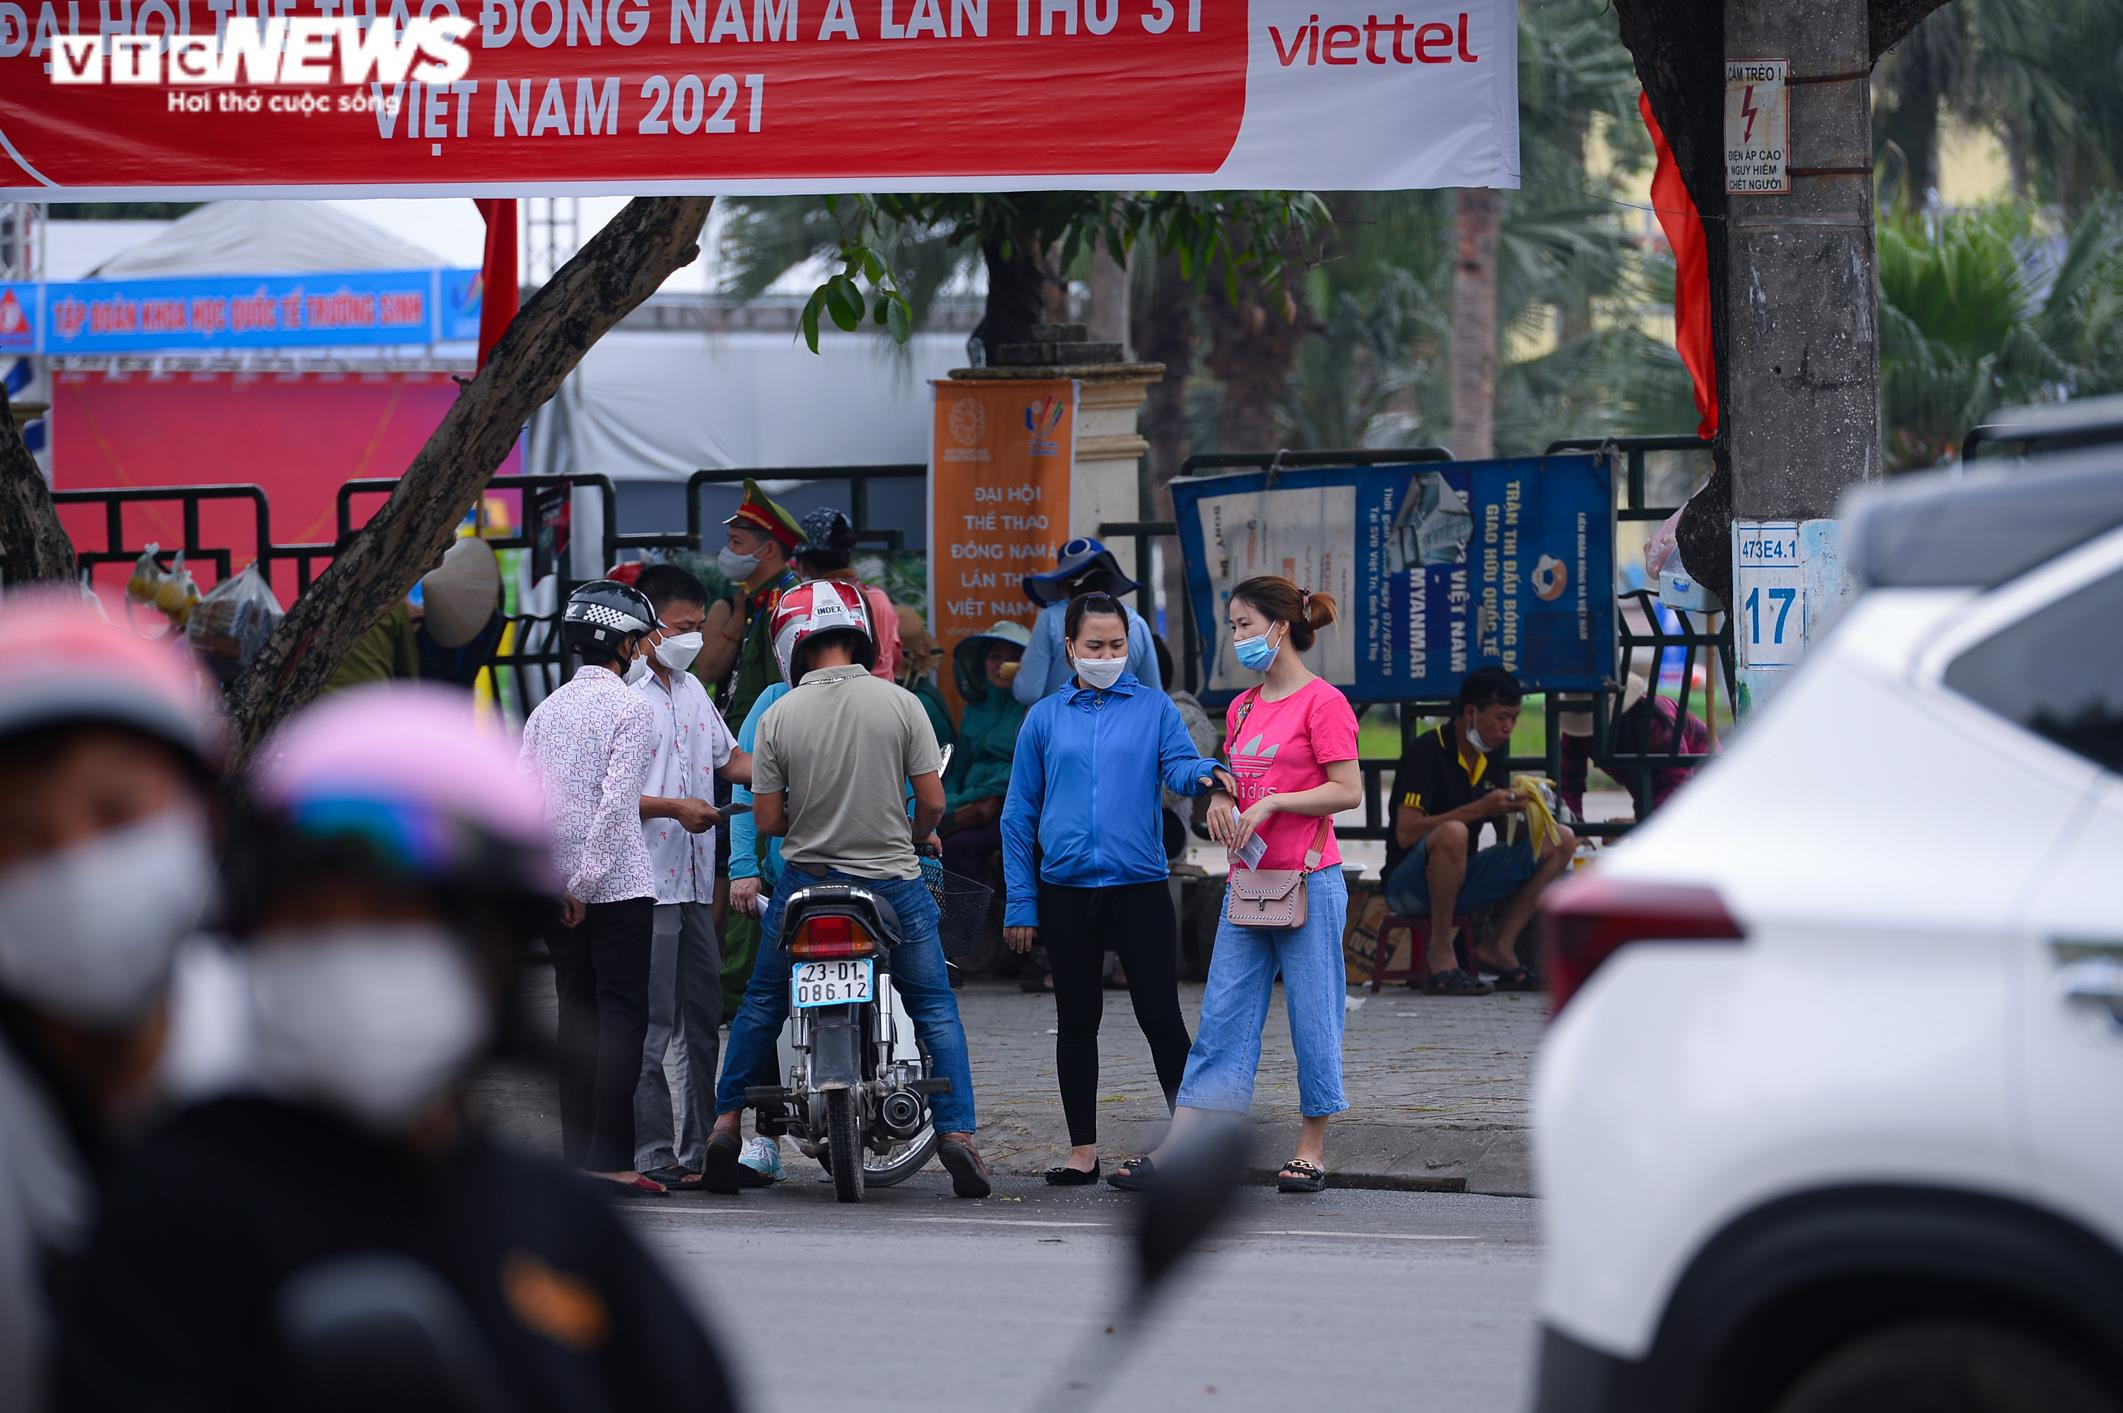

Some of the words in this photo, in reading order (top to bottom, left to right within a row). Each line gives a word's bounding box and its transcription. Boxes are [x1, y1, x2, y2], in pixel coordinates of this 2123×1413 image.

[670, 0, 798, 43] NAM
[1268, 12, 1478, 67] viettel
[1745, 64, 1774, 80] TRÈO
[371, 80, 478, 156] VIỆT
[494, 77, 621, 137] NAM
[638, 74, 764, 135] 2021
[1728, 150, 1743, 163] ĐIỆN
[1745, 149, 1757, 160] ÁP
[1759, 150, 1781, 160] CAO
[1731, 165, 1751, 175] NGUY
[1753, 162, 1777, 175] HIỂM
[1729, 178, 1746, 190] CHẾT
[1749, 177, 1781, 190] NGƯỜI
[973, 486, 1002, 506] ĐẠI
[1008, 484, 1041, 506] HỘI
[1503, 480, 1520, 525] TRẬN
[1002, 515, 1049, 530] THAO
[1484, 504, 1499, 543] GIAO
[950, 539, 1003, 559] ĐÔNG
[1009, 543, 1045, 559] NAM
[1504, 529, 1518, 556] THI
[1742, 540, 1796, 559] 473E4.1
[1483, 548, 1500, 581] HỮU
[1503, 560, 1521, 593] ĐẤU
[1447, 570, 1471, 615] VIỆT
[817, 605, 842, 615] INDEX
[946, 598, 985, 619] VIỆT
[1745, 587, 1797, 644] 17
[1409, 567, 1426, 679] MYANMAR
[1503, 599, 1521, 645] BÓNG
[1451, 621, 1466, 673] NAM
[1483, 636, 1500, 657] TẾ
[1239, 782, 1278, 800] idas
[806, 962, 858, 982] 23-D1
[798, 982, 867, 1003] 086.12
